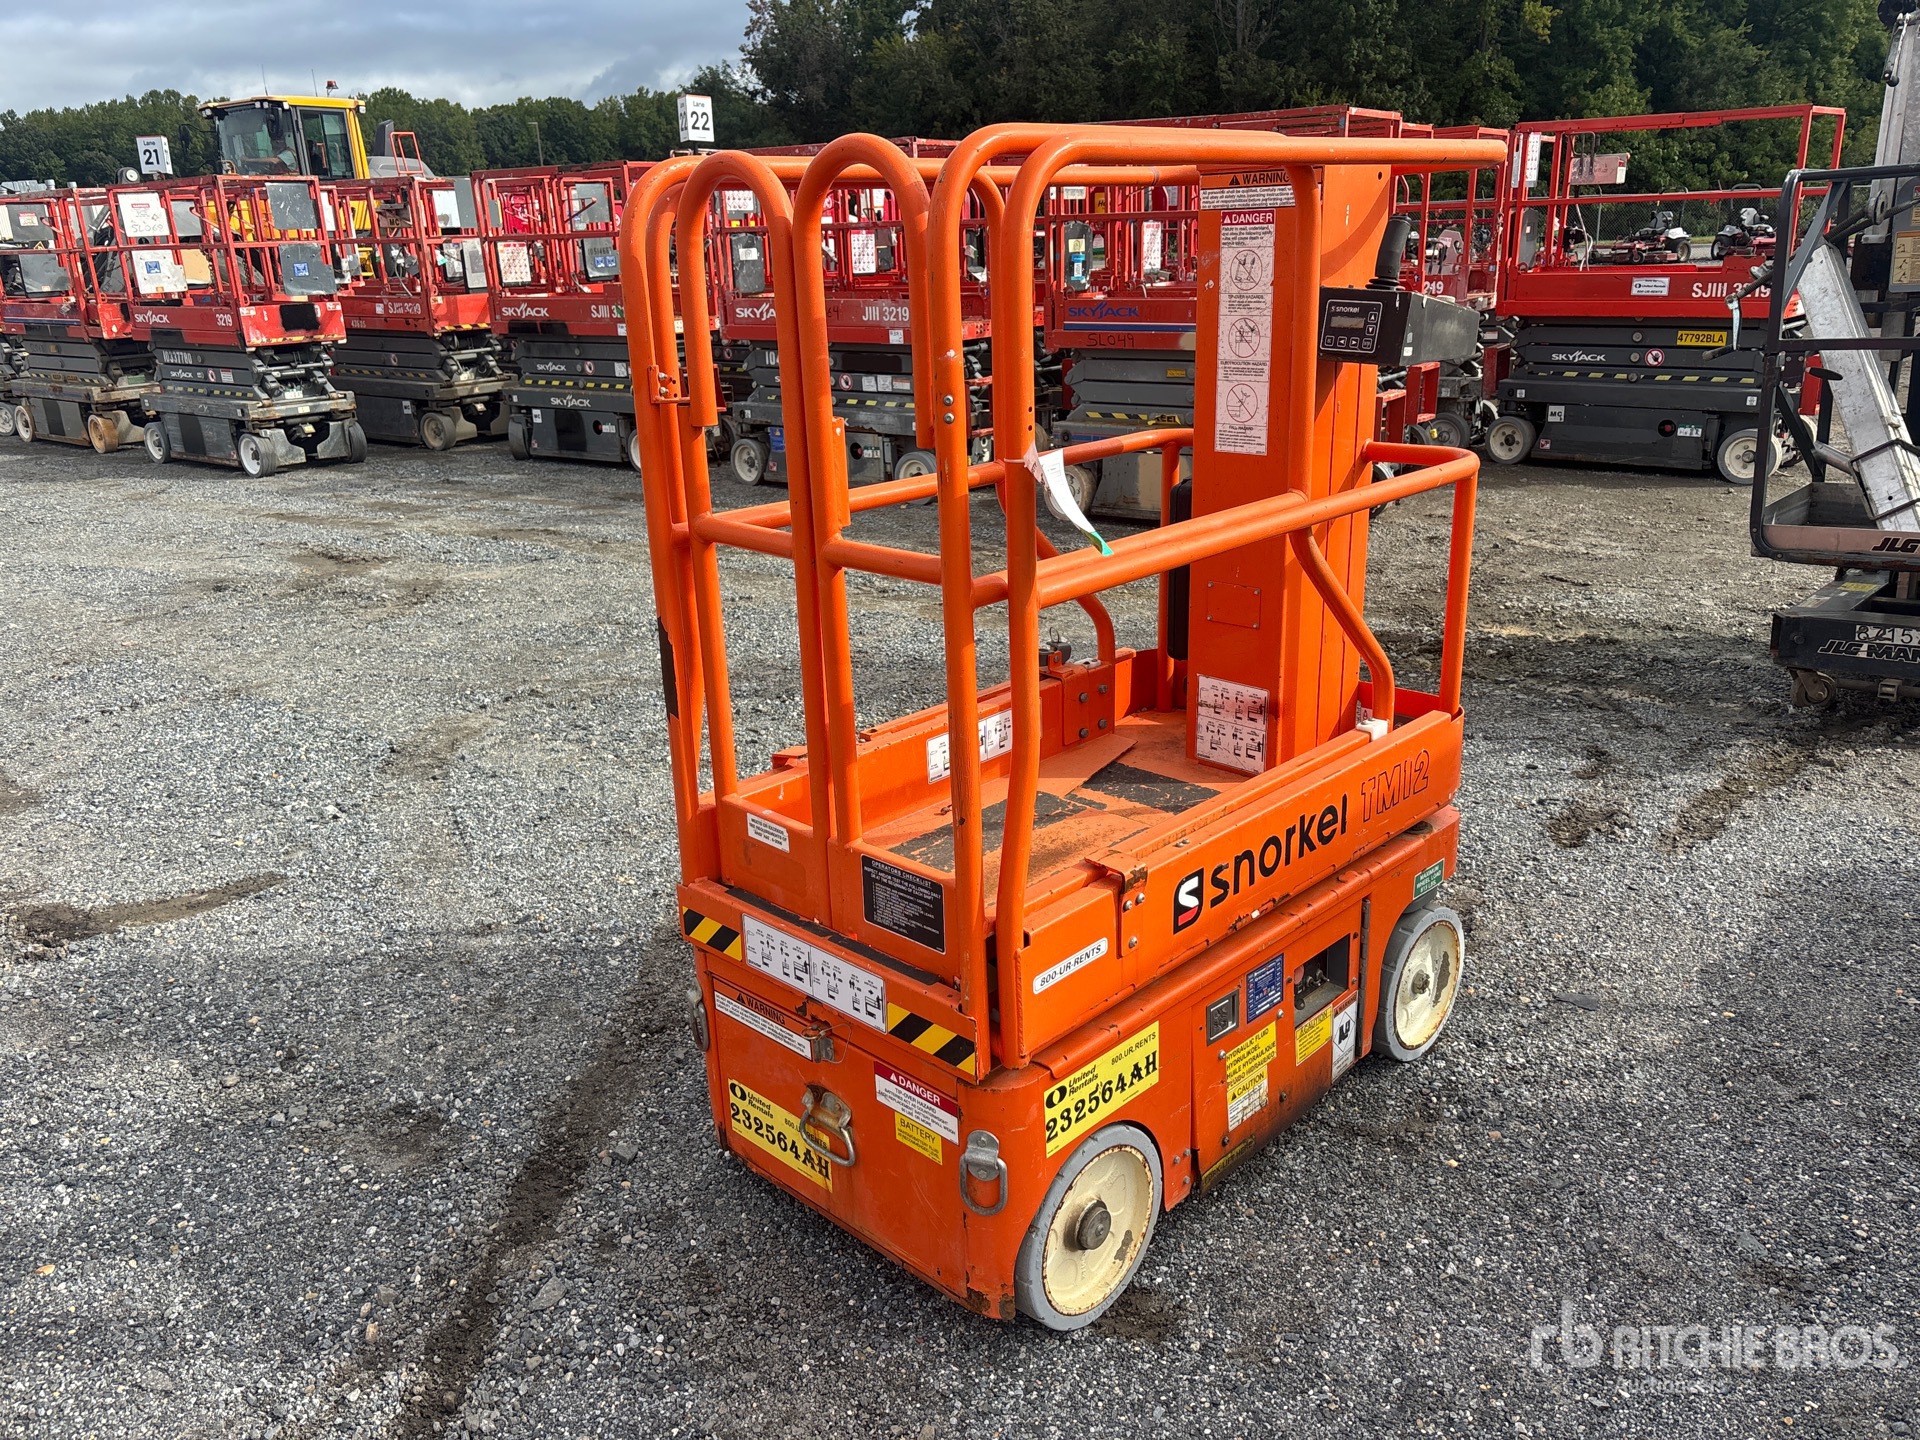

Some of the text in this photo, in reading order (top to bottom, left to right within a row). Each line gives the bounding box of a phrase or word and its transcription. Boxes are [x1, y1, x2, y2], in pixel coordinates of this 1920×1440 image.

[690, 111, 710, 131] 22
[143, 149, 160, 165] 21
[389, 218, 400, 226] MC
[1232, 213, 1273, 224] DANGER
[1692, 282, 1727, 298] SJIII
[134, 311, 233, 326] SKYJACK 3219
[501, 303, 549, 318] SKYJACK
[883, 307, 909, 322] 3219
[1068, 301, 1139, 319] SKYJACK
[1677, 333, 1724, 343] 47792BLA
[1552, 350, 1606, 363] SKYJACK
[170, 369, 193, 379] SKYJACK
[536, 362, 567, 372] SKYJACK
[550, 395, 591, 408] SKYJACK
[1872, 537, 1920, 554] JLG
[1817, 639, 1864, 657] JLG
[1210, 749, 1430, 909] snorkel TM12
[871, 859, 931, 887] OPERATORS CHECKLIST
[1040, 944, 1101, 987] 800-UR-RENTS
[746, 996, 786, 1026] WARNING
[1304, 1010, 1328, 1034] CAUTION
[1111, 1032, 1156, 1065] 800.UR.RENTS
[1226, 1028, 1269, 1063] HYDRAULIC FLUID
[1243, 1041, 1276, 1071] HYDRAULIQUE
[1069, 1064, 1097, 1087] United
[1069, 1073, 1099, 1097] Rentals
[1237, 1072, 1264, 1096] CAUTION
[748, 1092, 771, 1110] United
[899, 1076, 941, 1106] DANGER
[1046, 1050, 1158, 1143] 232564AH
[748, 1099, 774, 1119] Rentals
[900, 1118, 936, 1144] BATTERY
[730, 1102, 831, 1181] 232564AH
